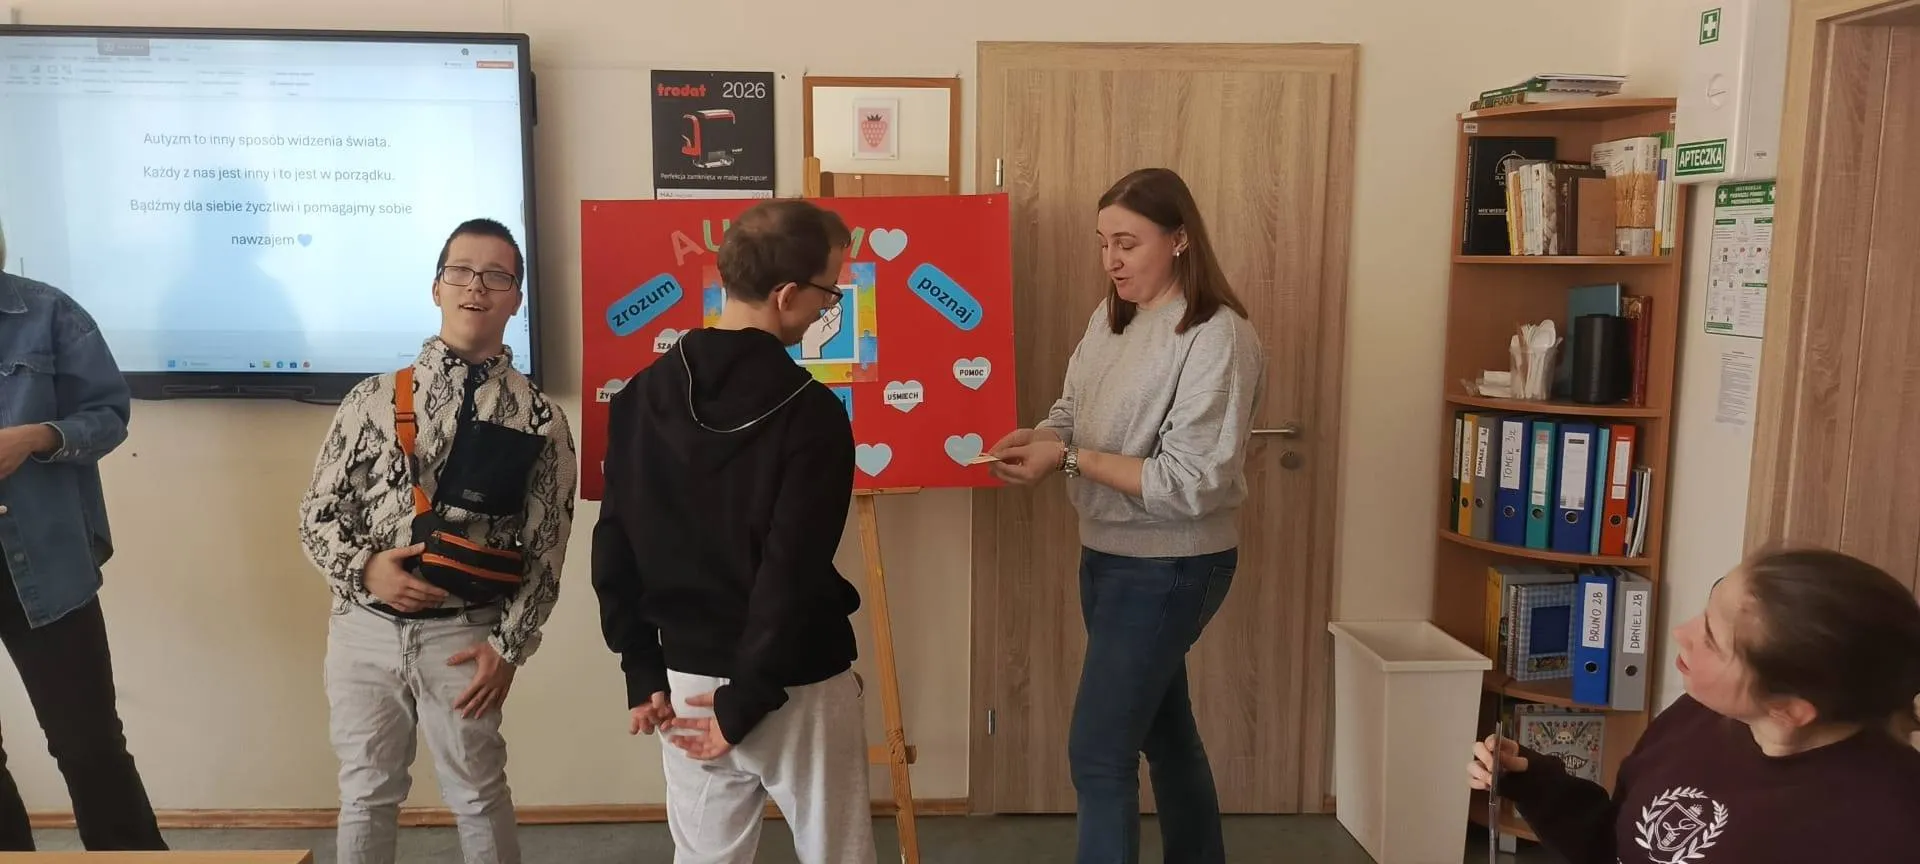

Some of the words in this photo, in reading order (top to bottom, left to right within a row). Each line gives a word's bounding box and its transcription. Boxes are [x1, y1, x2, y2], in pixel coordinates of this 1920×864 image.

[656, 83, 706, 97] trodat
[722, 81, 766, 99] 2026
[143, 133, 191, 147] Autyzm
[194, 134, 207, 145] to
[210, 134, 236, 148] inny
[239, 135, 285, 147] sposób
[287, 136, 343, 147] widzenia
[346, 136, 391, 148] świata.
[1679, 147, 1722, 168] APTECZKA
[143, 166, 181, 181] Każdy
[183, 170, 190, 178] z
[193, 169, 216, 179] nas
[217, 167, 241, 181] jest
[244, 168, 270, 182] inny
[280, 169, 292, 180] to
[294, 168, 317, 182] jest
[320, 171, 332, 180] w
[334, 169, 396, 183] porządku.
[130, 199, 181, 213] Bądźmy
[184, 199, 203, 211] dla
[206, 199, 243, 212] siebie
[245, 200, 294, 214] życzliwi
[303, 203, 375, 216] pomagajmy
[379, 203, 413, 214] sobie
[231, 235, 295, 247] nawzajem
[612, 279, 675, 327] zrozum
[917, 277, 976, 324] poznaj
[959, 369, 984, 377] POMOC
[887, 390, 919, 401] UŚMIECH
[1504, 448, 1515, 479] TOMEK
[1589, 608, 1602, 642] BRUNO
[1630, 610, 1642, 648] DANIEL
